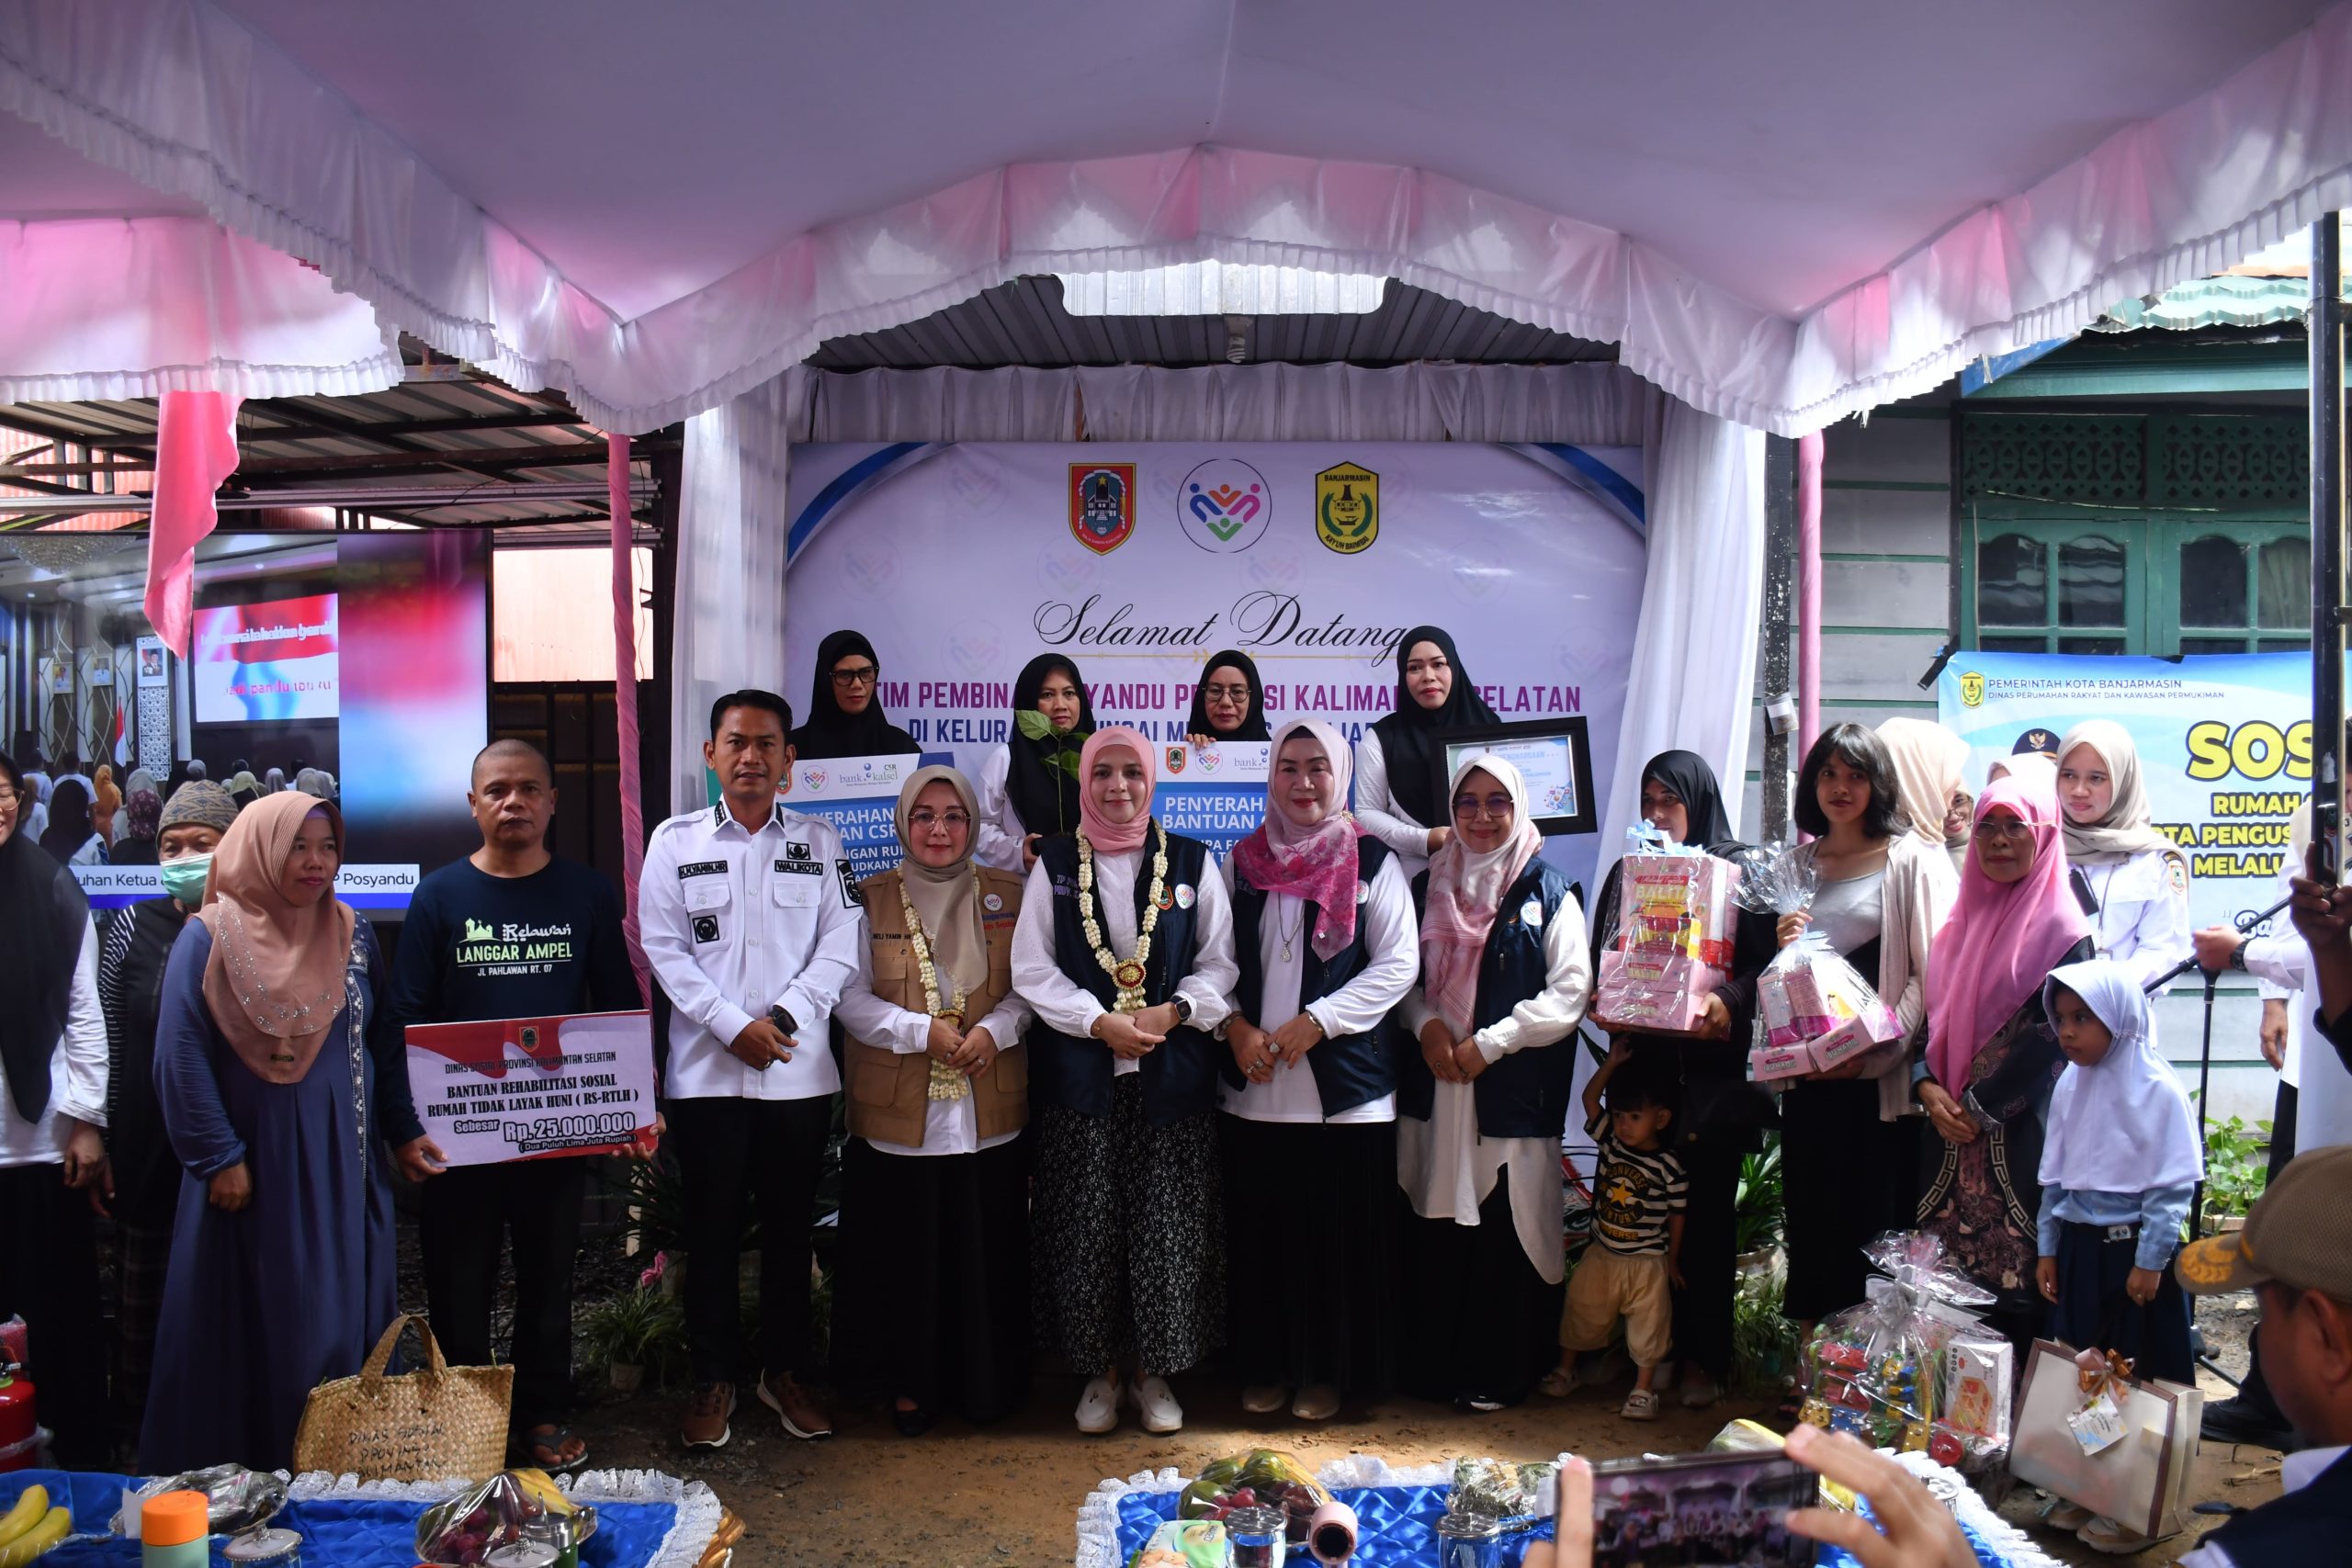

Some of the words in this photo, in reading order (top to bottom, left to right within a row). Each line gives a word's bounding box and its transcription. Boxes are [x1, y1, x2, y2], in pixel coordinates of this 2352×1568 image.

[1035, 593, 1219, 646] Selamat
[1230, 591, 1408, 667] Datang
[1988, 679, 2062, 689] PEMERINTAH
[2065, 679, 2096, 689] KOTA
[2099, 679, 2182, 689] BANJARMASIN
[919, 682, 1015, 708] PEMBIN
[910, 718, 928, 743] DI
[1166, 796, 1266, 812] PENYERAH
[2211, 793, 2301, 818] RUMAH
[1162, 814, 1255, 829] BANTUAN
[777, 863, 821, 874] WALIKOTA
[116, 874, 157, 886] Ketua
[344, 873, 414, 888] Posyandu
[503, 923, 571, 942] Relawan
[457, 944, 520, 964] LANGGAR
[526, 942, 573, 960] AMPEL
[478, 967, 486, 976] JL
[489, 965, 527, 976] PAHLAWAN
[530, 964, 541, 974] RT.
[544, 964, 553, 973] 07
[499, 1057, 534, 1070] PROVINSI
[584, 1051, 616, 1064] SELATAN
[447, 1082, 497, 1099] BANTUAN
[501, 1077, 577, 1095] REHABILITASI
[581, 1073, 617, 1089] SOSIAL
[427, 1102, 467, 1118] RUMAH
[470, 1100, 505, 1114] TIDAK
[509, 1097, 543, 1111] LAYAK
[547, 1093, 573, 1108] HUNI
[583, 1089, 631, 1106] RS-RTLH
[454, 1119, 500, 1134] Sebesar
[525, 1143, 540, 1151] Dua
[542, 1141, 564, 1149] Puluh
[566, 1139, 584, 1147] Lima
[587, 1137, 603, 1145] Juta
[605, 1135, 631, 1145] Rupiah
